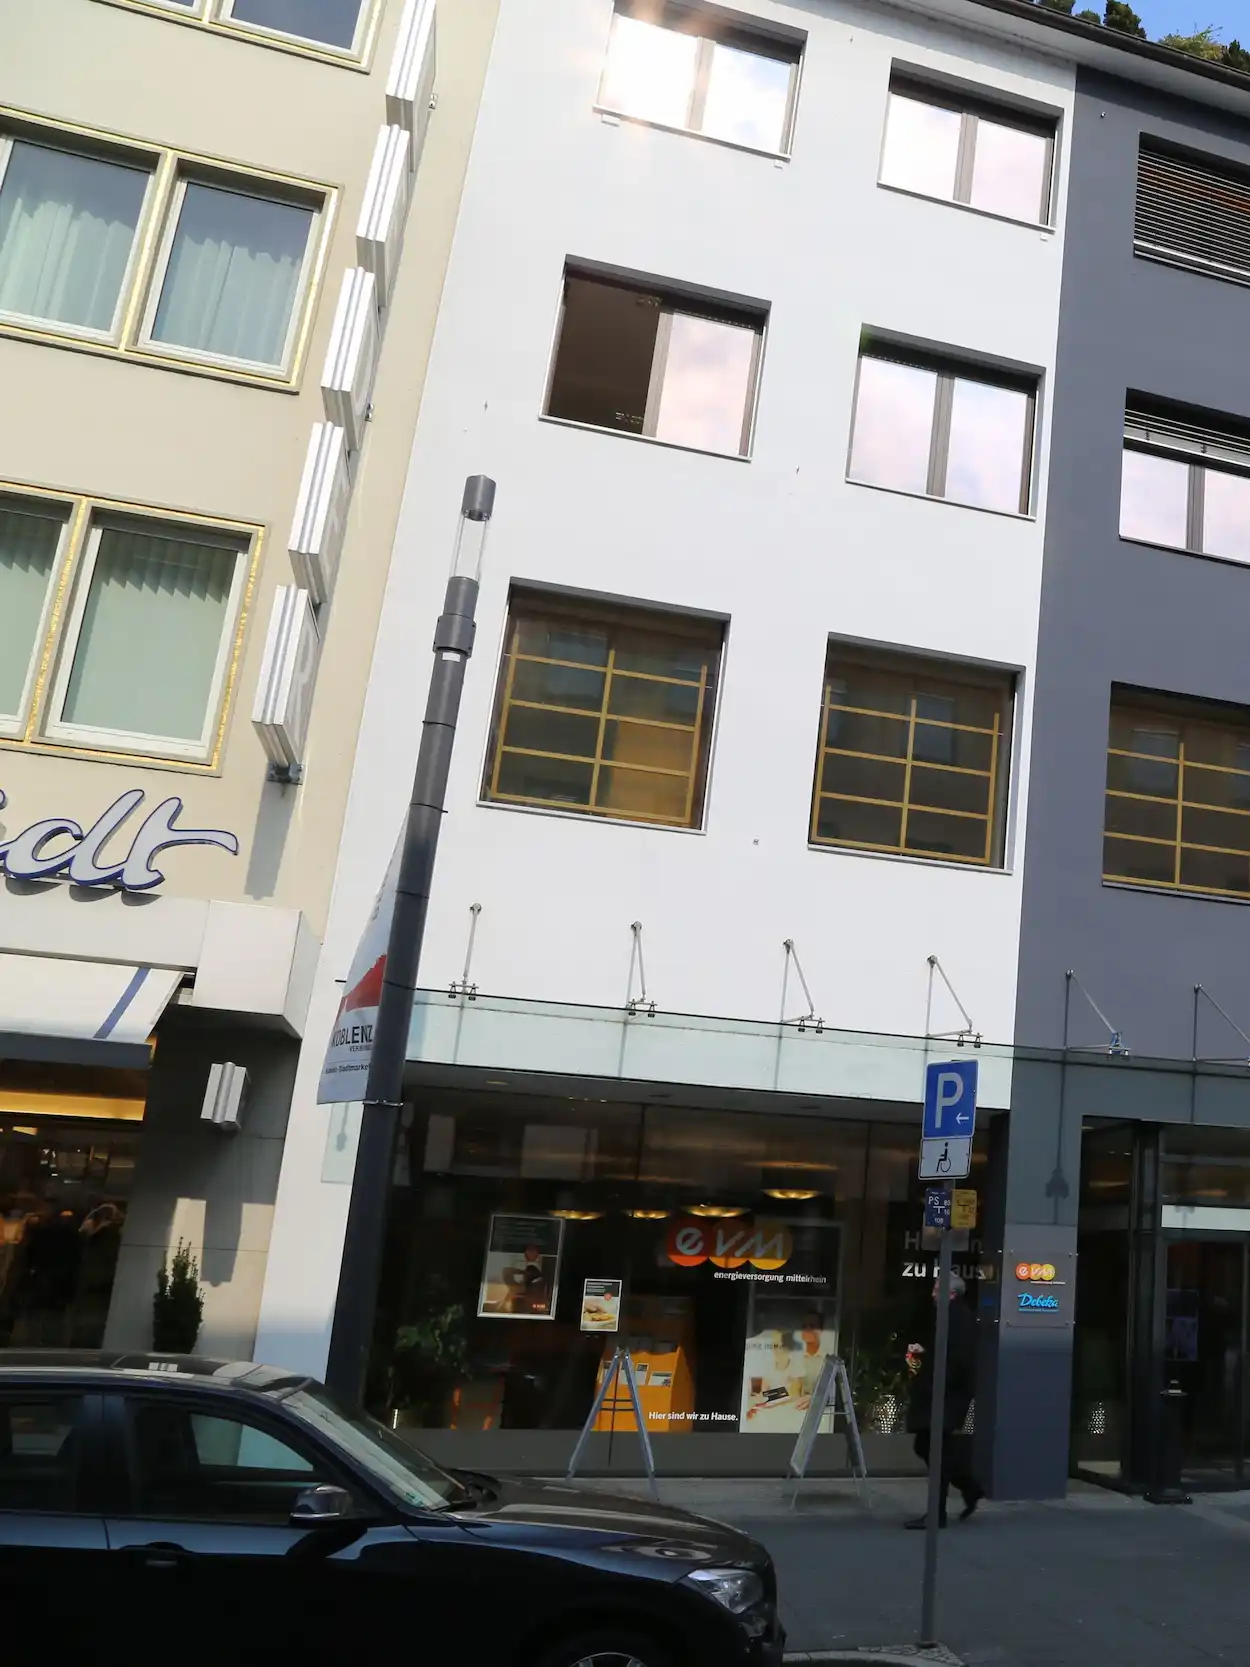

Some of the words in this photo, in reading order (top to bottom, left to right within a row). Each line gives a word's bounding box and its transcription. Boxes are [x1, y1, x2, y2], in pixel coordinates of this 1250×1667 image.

[331, 1024, 373, 1047] KOBLENZ
[935, 1072, 964, 1129] P
[713, 1271, 784, 1283] energieversorgung
[785, 1274, 827, 1284] mittelrhein
[902, 1262, 927, 1278] zu
[1017, 1293, 1059, 1308] Debeka
[648, 1411, 666, 1420] Hier
[667, 1411, 685, 1420] sind
[686, 1411, 699, 1420] wir
[699, 1412, 710, 1420] zu
[710, 1412, 739, 1421] Hause.
